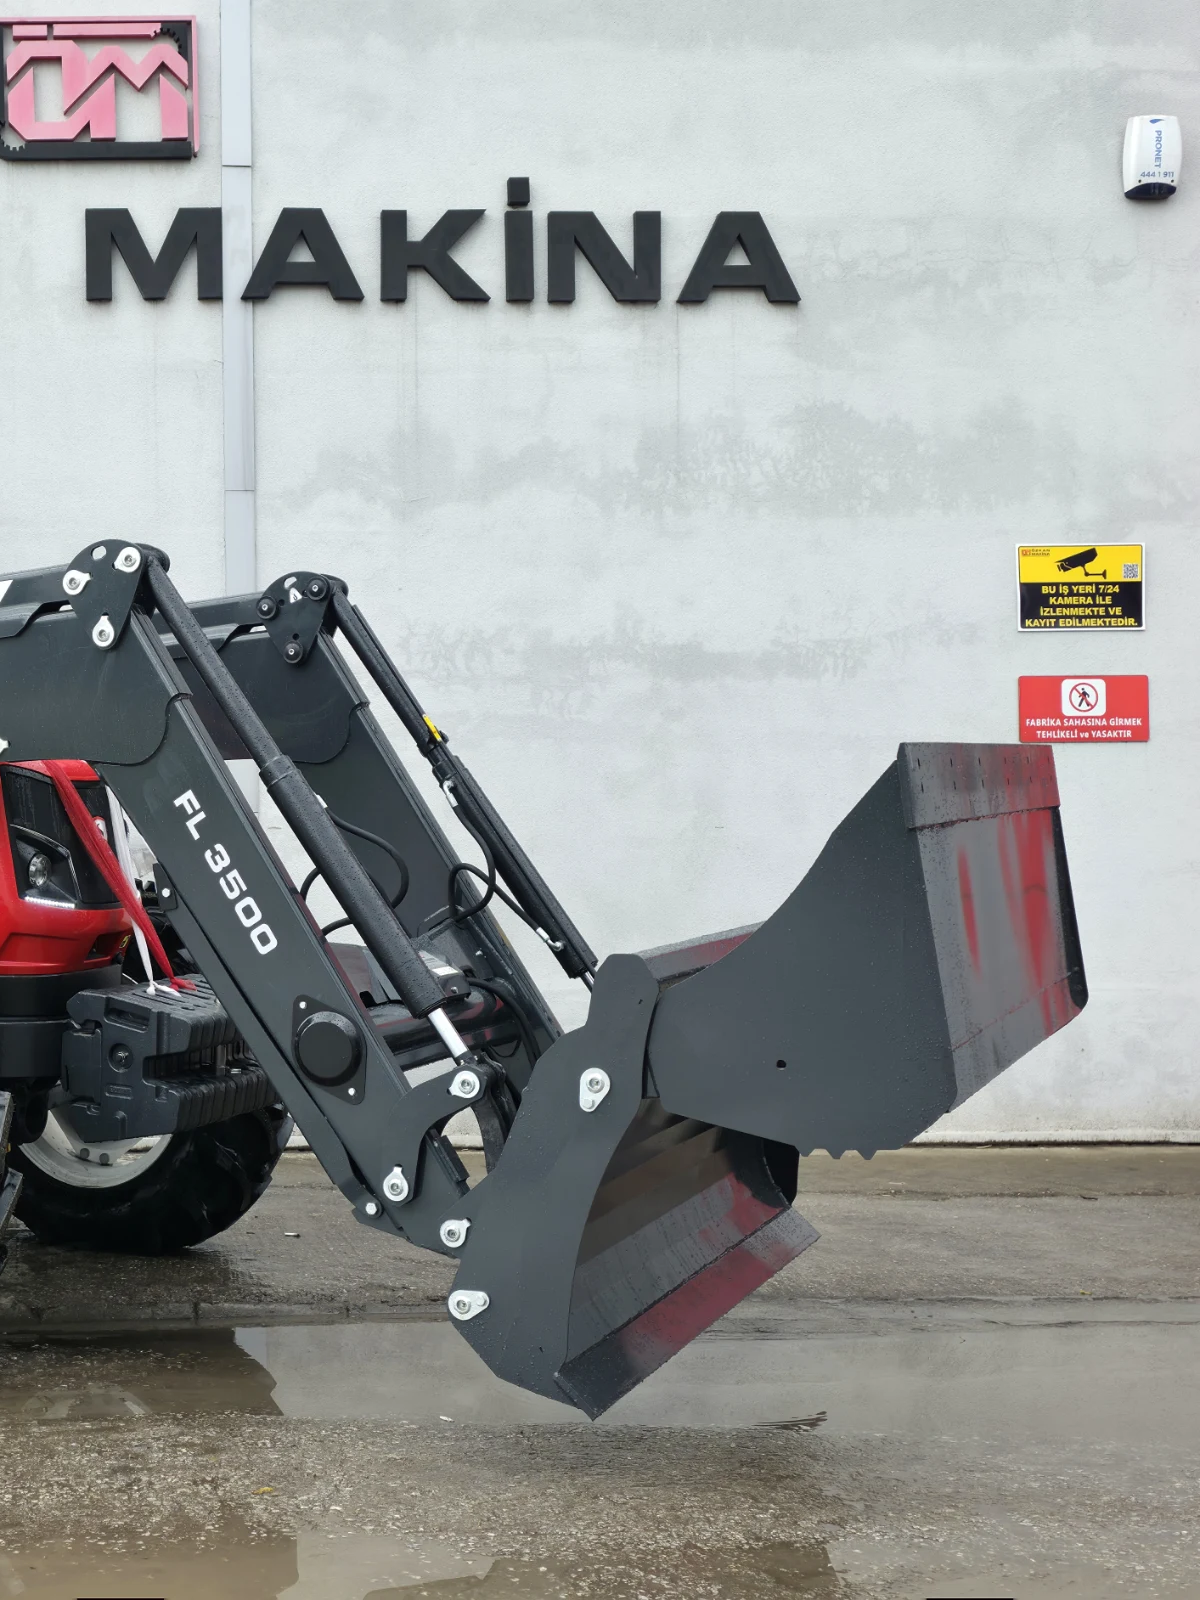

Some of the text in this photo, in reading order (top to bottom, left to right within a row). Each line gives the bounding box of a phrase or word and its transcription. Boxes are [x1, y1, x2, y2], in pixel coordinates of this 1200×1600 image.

[1154, 130, 1163, 168] PRONET
[85, 177, 802, 305] MAKİNA
[1041, 584, 1119, 595] BU İŞ YERİ 7/24
[1049, 595, 1112, 605] KAMERA İLE
[1040, 606, 1122, 616] İZLENMEKTE VE
[1025, 616, 1138, 627] KAYIT EDİLMEKTEDİR.
[1026, 716, 1142, 727] FABRİKA SAHASINA GİRMEK
[1036, 729, 1078, 738] TEHLİKELİ
[1091, 730, 1132, 738] YASAKTIR
[173, 789, 278, 955] FL 3500
